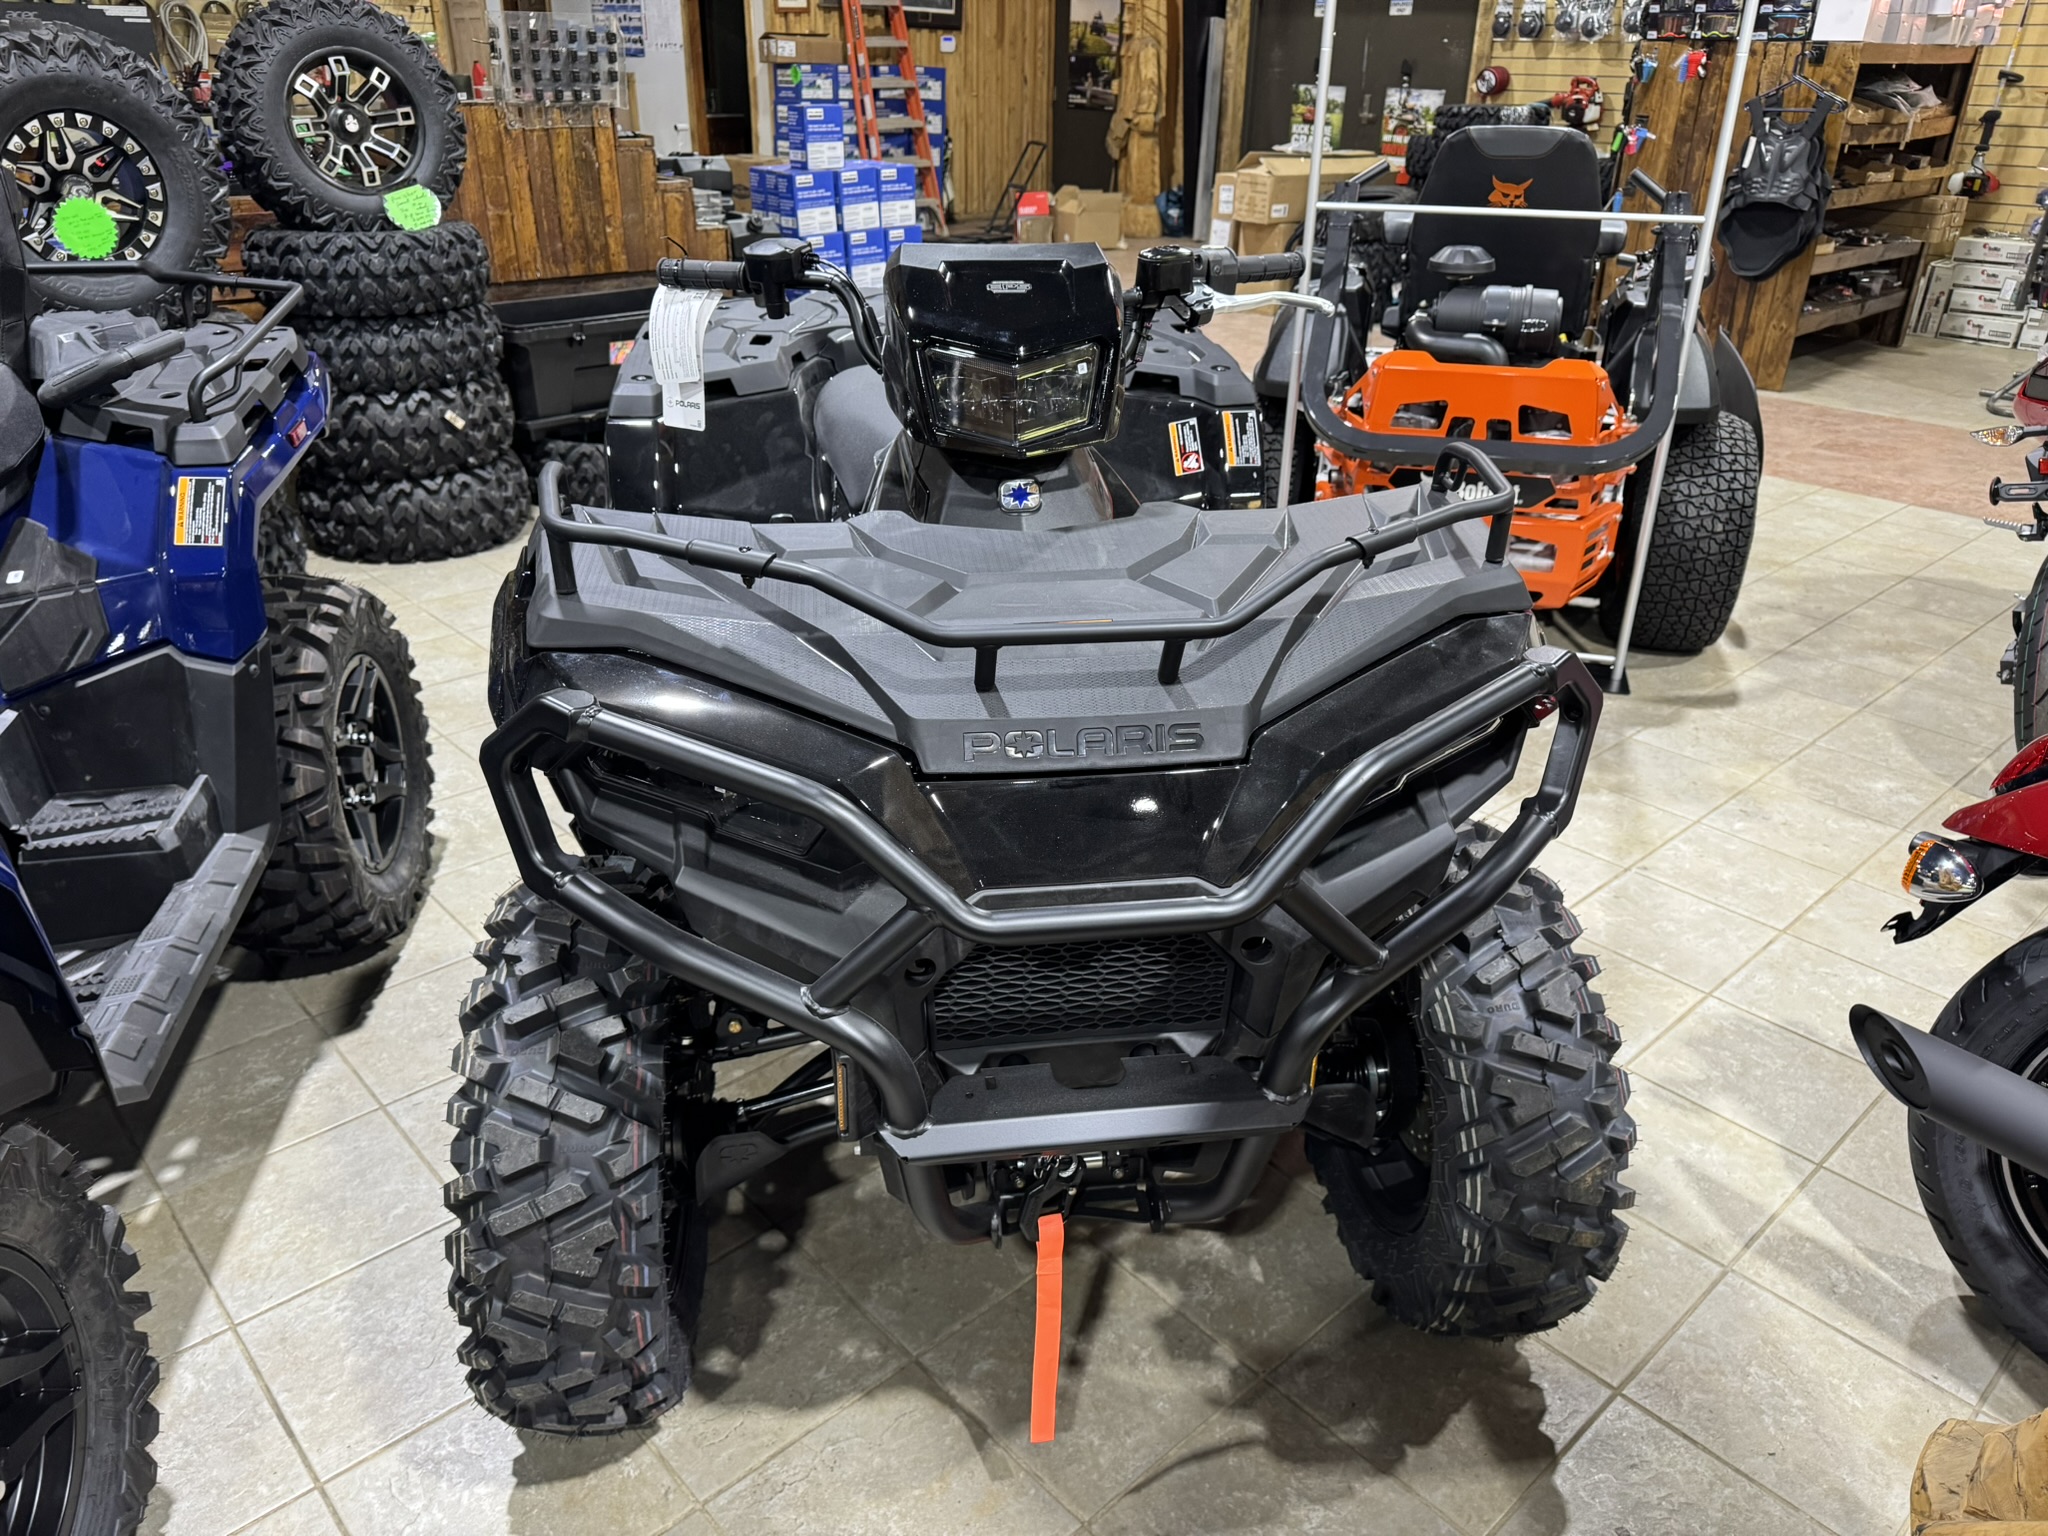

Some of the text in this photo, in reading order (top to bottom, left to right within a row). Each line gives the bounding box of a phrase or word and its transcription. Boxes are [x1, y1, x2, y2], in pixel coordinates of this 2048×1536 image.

[675, 399, 701, 410] POLARIS
[177, 492, 186, 521] WARNING
[963, 722, 1204, 762] POLARIS
[1486, 1001, 1521, 1014] DURO
